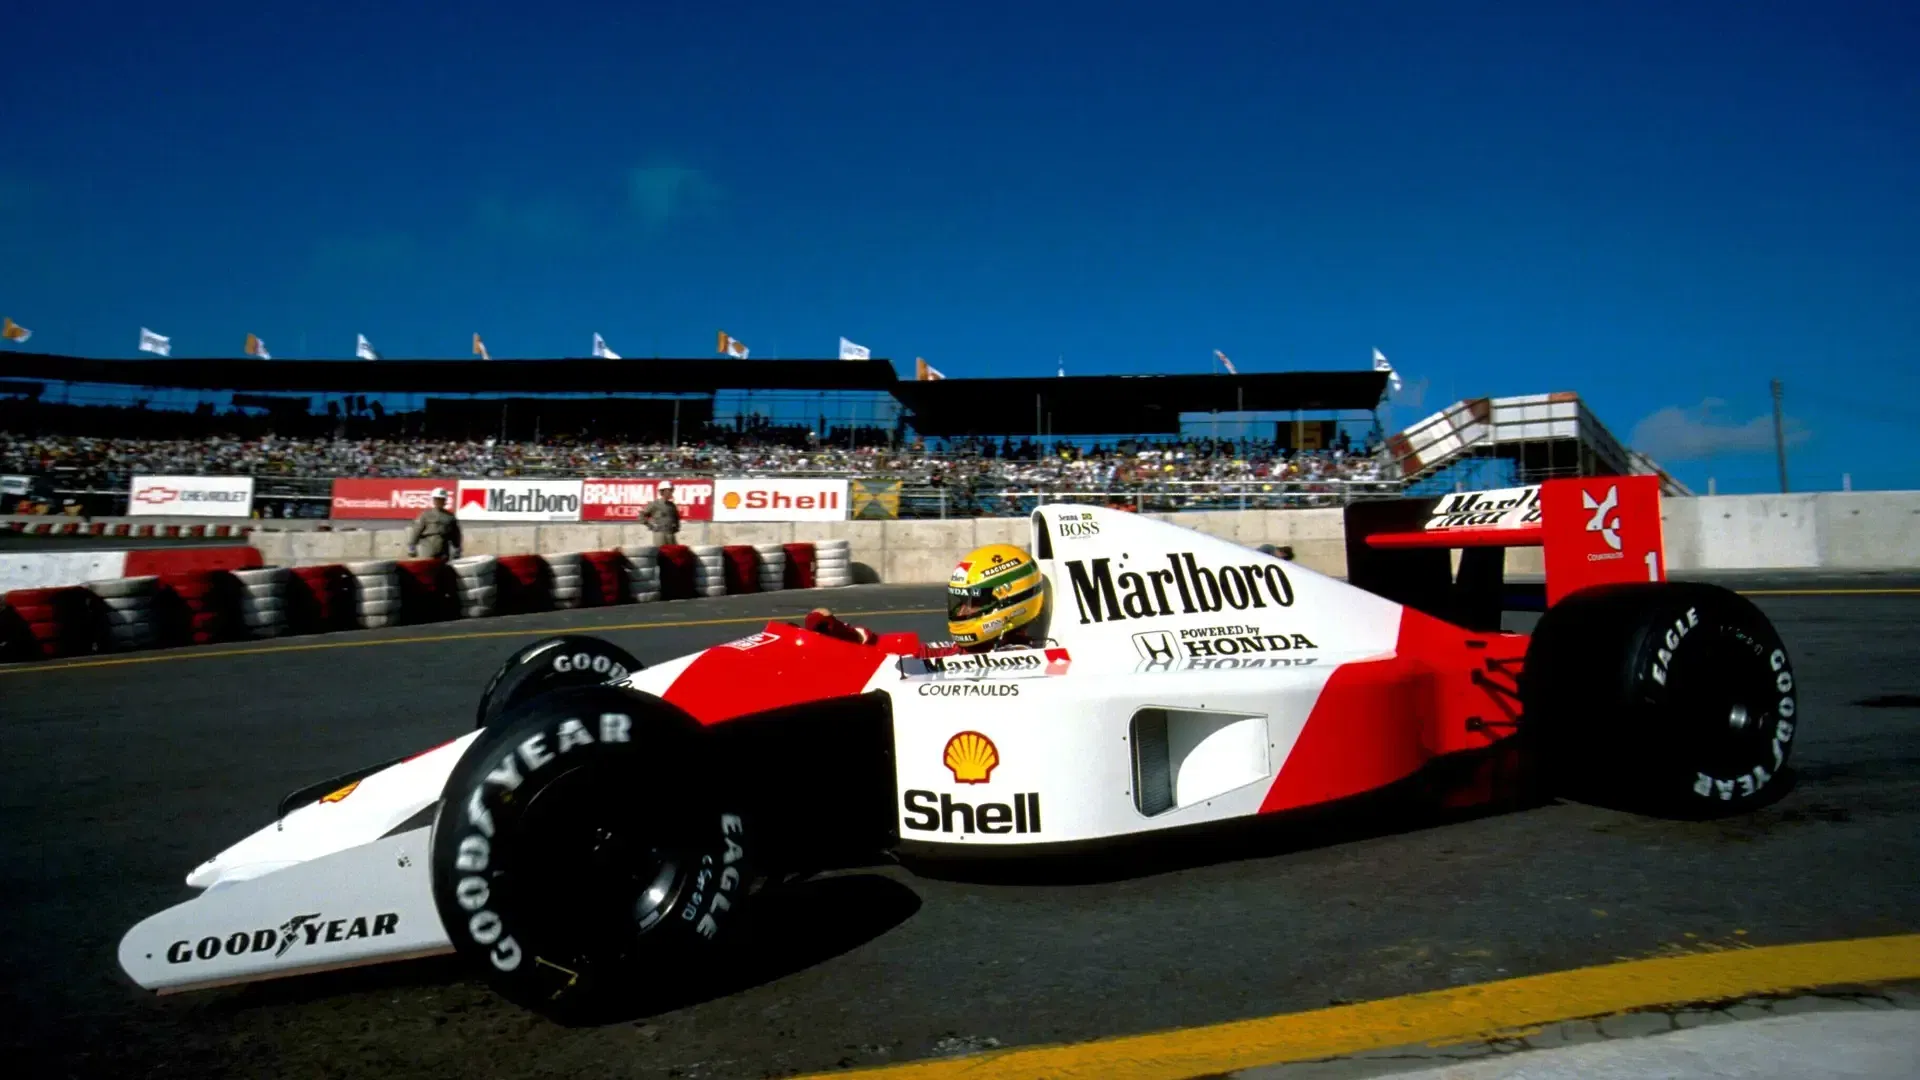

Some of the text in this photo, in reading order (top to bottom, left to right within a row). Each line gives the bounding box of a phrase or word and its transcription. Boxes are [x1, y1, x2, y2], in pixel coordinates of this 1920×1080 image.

[487, 488, 578, 512] Marlboro
[745, 490, 838, 509] Shell
[1059, 522, 1100, 537] BOSS
[1644, 551, 1658, 582] 1
[1065, 552, 1295, 624] Marlboro
[1180, 625, 1260, 639] POWERED by
[1183, 634, 1319, 657] HONDA
[1652, 607, 1699, 686] EAGLE
[922, 653, 1041, 673] Marlboro
[918, 683, 1020, 697] COURTAULDS
[904, 789, 1041, 834] Shell
[697, 813, 743, 939] EAGLE
